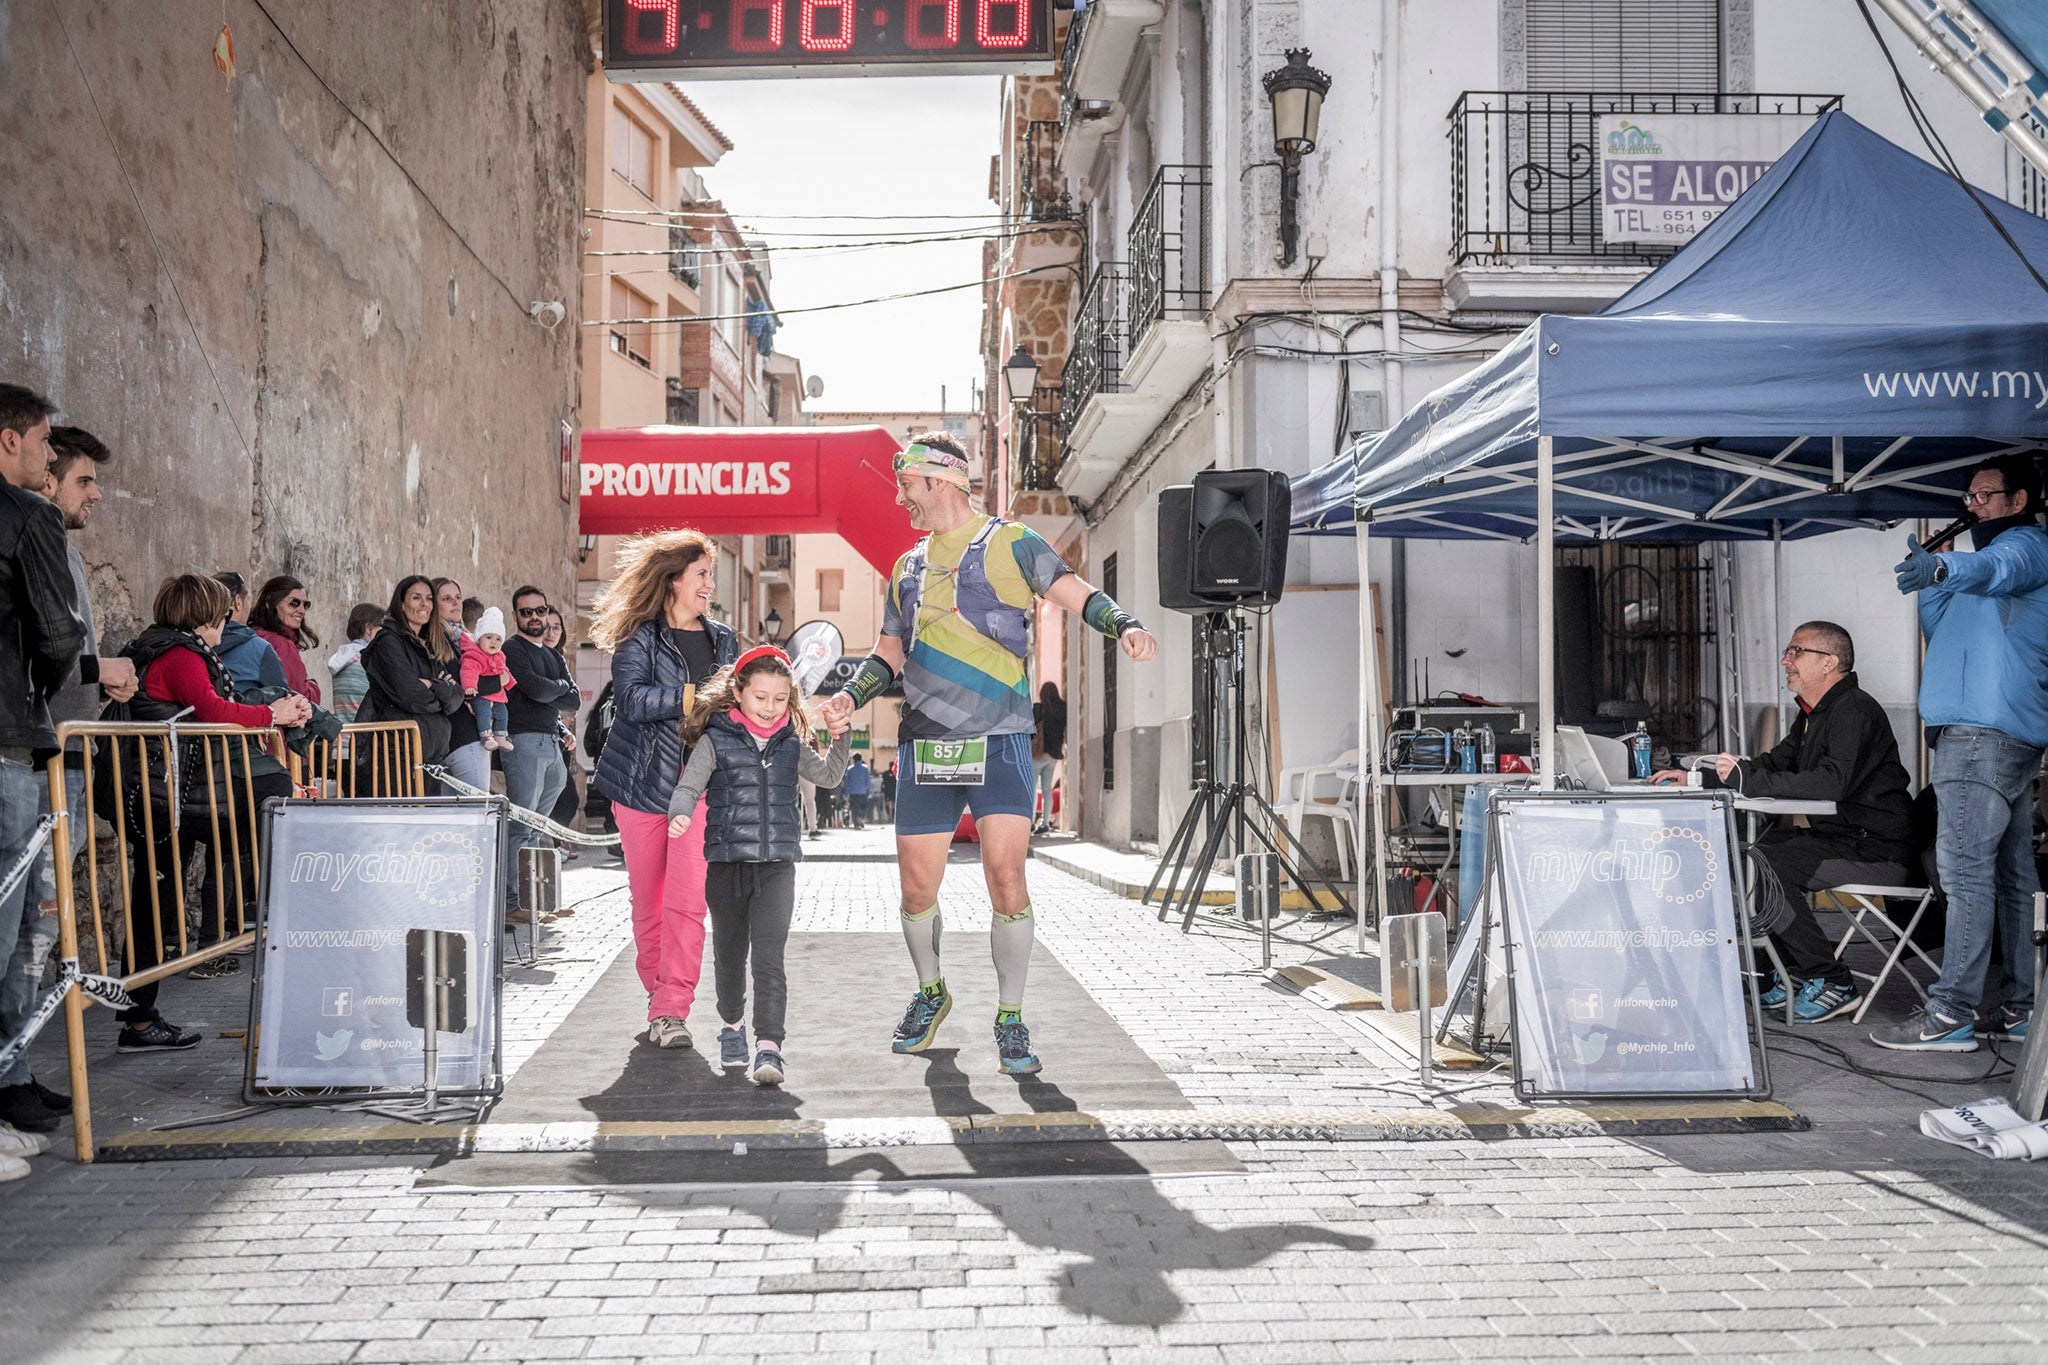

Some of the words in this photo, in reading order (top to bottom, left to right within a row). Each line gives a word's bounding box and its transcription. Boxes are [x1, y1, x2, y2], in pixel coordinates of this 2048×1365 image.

[1611, 164, 1654, 201] SE
[1662, 210, 1694, 221] 651
[1663, 224, 1696, 235] 964
[580, 461, 791, 497] PROVINCIAS
[933, 744, 964, 759] 857
[290, 842, 449, 894] mychip
[1527, 839, 1682, 892] mychip
[1532, 925, 1720, 953] www.mychip.es
[362, 995, 407, 1007] /infomy
[1616, 1041, 1696, 1055] @Mychip_Info
